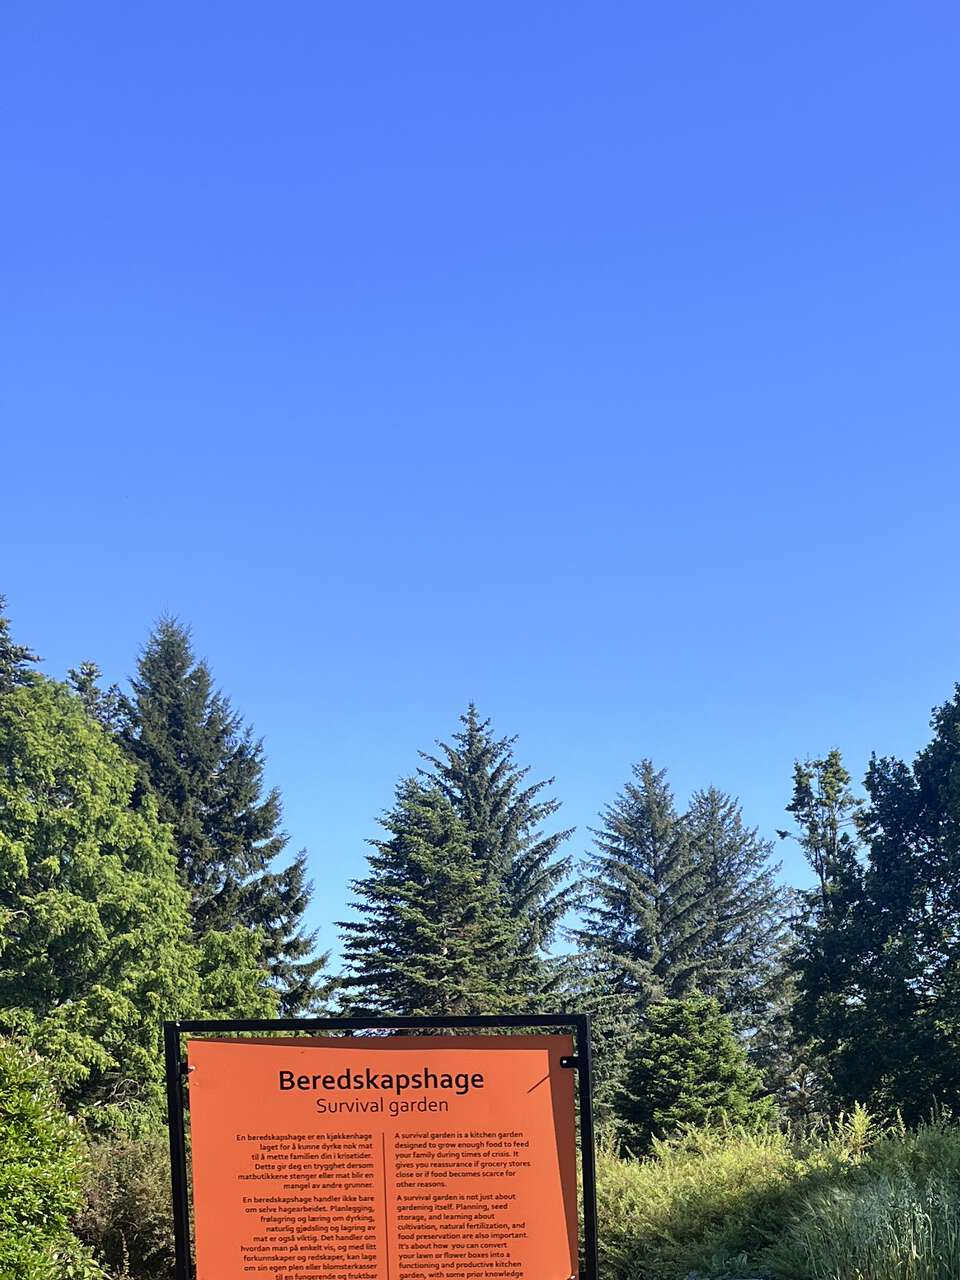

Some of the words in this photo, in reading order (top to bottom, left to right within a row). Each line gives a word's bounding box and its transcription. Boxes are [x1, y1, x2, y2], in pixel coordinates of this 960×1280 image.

[279, 1068, 484, 1094] Beredskapshage
[316, 1097, 384, 1113] Survival
[389, 1097, 448, 1117] garden
[247, 1132, 305, 1142] beredskapshage
[326, 1132, 372, 1142] kjøkkenhage
[401, 1131, 429, 1139] survival
[430, 1131, 455, 1141] garden
[469, 1130, 496, 1138] kitchen
[497, 1130, 523, 1140] garden
[395, 1140, 427, 1150] designed
[428, 1140, 436, 1148] to
[437, 1142, 456, 1150] grow
[457, 1140, 484, 1150] enough
[485, 1140, 502, 1148] food
[503, 1140, 511, 1148] to
[266, 1152, 288, 1160] mette
[289, 1152, 319, 1160] familien
[395, 1152, 411, 1160] your
[412, 1150, 435, 1160] family
[436, 1150, 460, 1160] during
[461, 1150, 481, 1158] times
[513, 1149, 519, 1157] It
[255, 1162, 275, 1170] Dette
[276, 1162, 286, 1172] gir
[288, 1162, 302, 1172] deg
[313, 1161, 345, 1171] trygghet
[346, 1161, 374, 1169] dersom
[395, 1160, 414, 1170] gives
[415, 1162, 429, 1170] you
[508, 1159, 531, 1167] stores
[396, 1170, 414, 1178] close
[448, 1169, 480, 1177] becomes
[505, 1169, 516, 1177] for
[396, 1180, 415, 1188] other
[243, 1195, 252, 1203] En
[253, 1195, 312, 1205] beredskapshage
[358, 1194, 374, 1202] bare
[403, 1193, 431, 1201] survival
[432, 1192, 457, 1202] garden
[458, 1192, 464, 1200] is
[466, 1192, 478, 1200] not
[479, 1192, 493, 1202] just
[494, 1192, 516, 1200] about
[258, 1205, 276, 1213] selve
[397, 1203, 433, 1213] gardening
[491, 1202, 508, 1210] seed
[260, 1214, 295, 1224] frølagring
[297, 1216, 306, 1224] og
[307, 1214, 331, 1224] læring
[428, 1212, 442, 1220] and
[473, 1211, 495, 1219] about
[266, 1224, 294, 1234] naturlig
[295, 1224, 328, 1234] gjødsling
[340, 1223, 366, 1233] lagring
[439, 1221, 465, 1229] natural
[511, 1221, 525, 1229] and
[253, 1234, 267, 1242] mat
[278, 1234, 295, 1244] også
[320, 1233, 334, 1241] Det
[335, 1233, 362, 1241] handler
[398, 1232, 414, 1240] food
[415, 1231, 460, 1241] preservation
[474, 1231, 489, 1239] also
[241, 1244, 270, 1252] hvordan
[289, 1243, 298, 1253] på
[299, 1243, 322, 1251] enkelt
[337, 1245, 347, 1253] og
[410, 1241, 431, 1249] about
[432, 1241, 448, 1249] how
[451, 1243, 465, 1251] you
[480, 1240, 507, 1248] convert
[399, 1253, 414, 1261] your
[415, 1251, 433, 1259] lawn
[443, 1250, 466, 1258] flower
[467, 1250, 488, 1258] boxes
[489, 1250, 504, 1258] into
[399, 1260, 439, 1270] functioning
[441, 1260, 454, 1268] and
[455, 1260, 493, 1270] productive
[495, 1260, 521, 1268] kitchen
[275, 1272, 283, 1280] til
[347, 1272, 377, 1280] fruktbar
[428, 1270, 444, 1278] with
[466, 1270, 483, 1280] prior
[484, 1269, 523, 1279] knowledge
